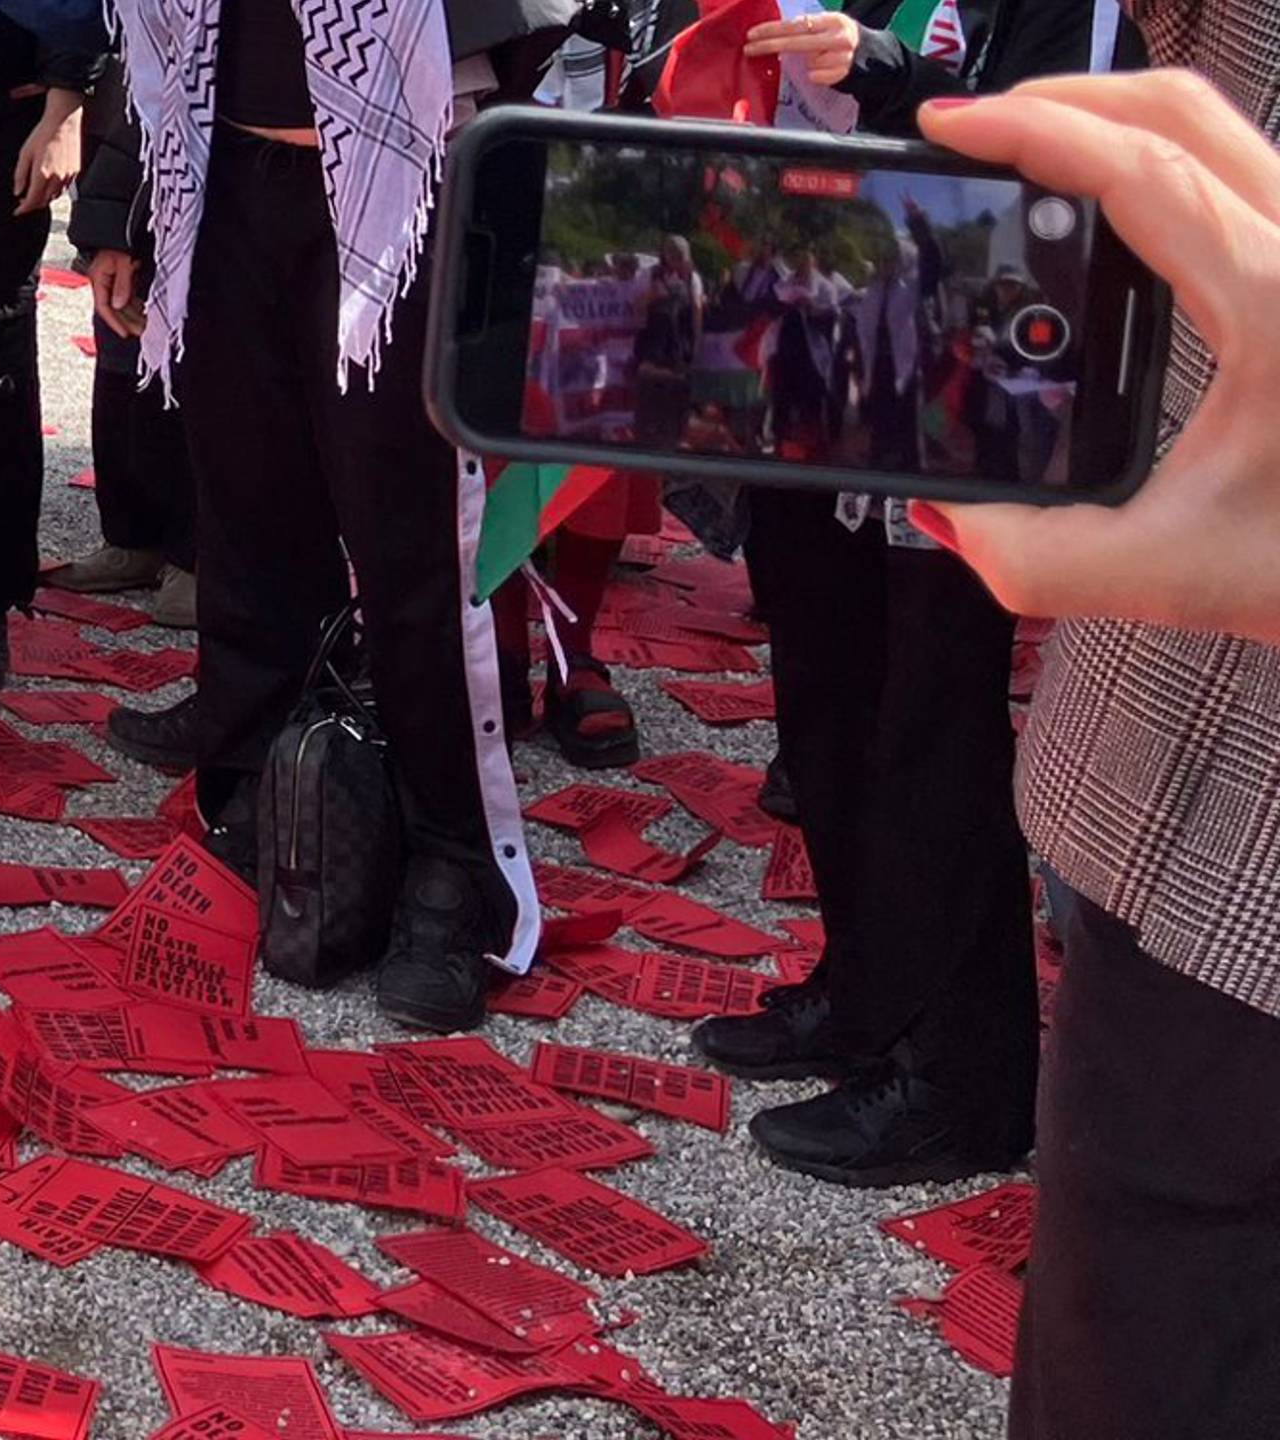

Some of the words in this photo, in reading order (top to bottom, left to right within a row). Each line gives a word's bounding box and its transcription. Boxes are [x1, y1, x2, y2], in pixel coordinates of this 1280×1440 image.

[172, 852, 199, 878] NO
[146, 883, 167, 903] IN
[158, 868, 213, 915] DEATH
[145, 913, 169, 933] NO
[142, 929, 199, 956] DEATH
[211, 1410, 245, 1432] NO
